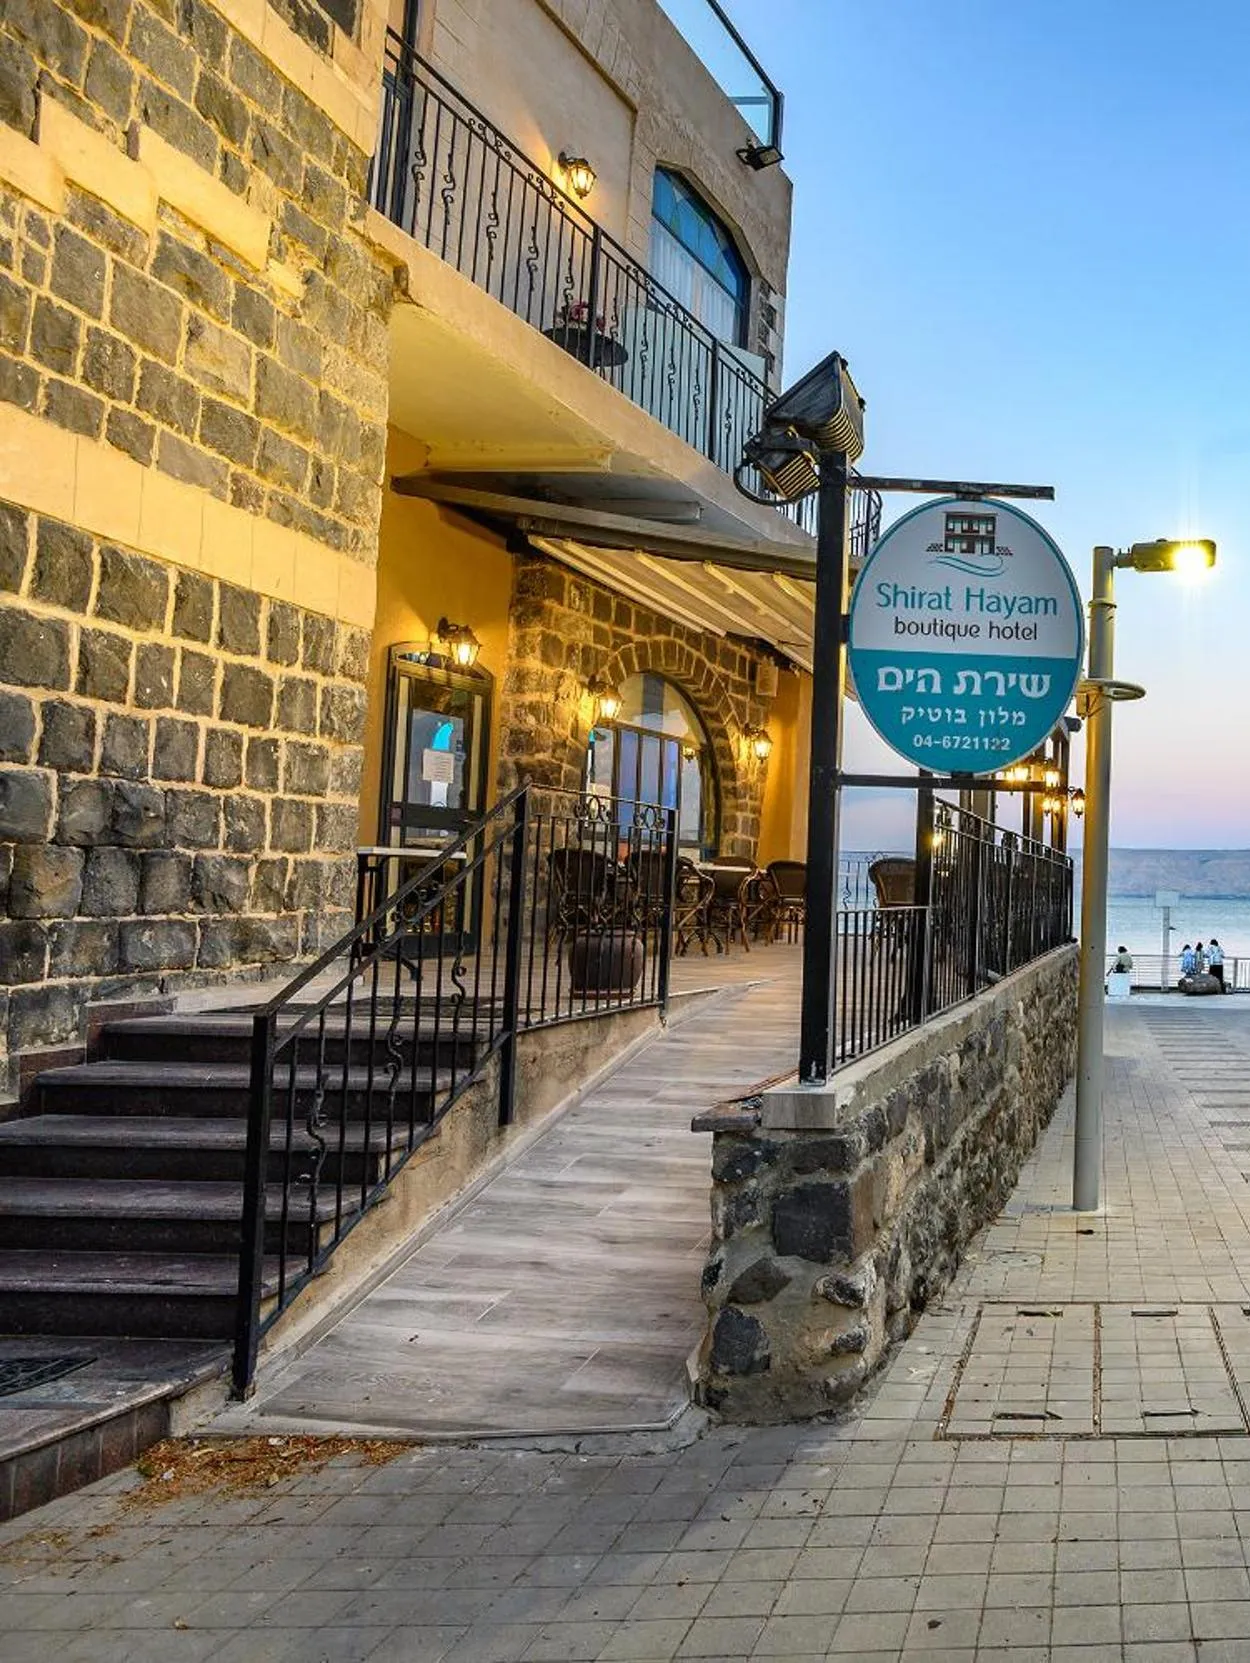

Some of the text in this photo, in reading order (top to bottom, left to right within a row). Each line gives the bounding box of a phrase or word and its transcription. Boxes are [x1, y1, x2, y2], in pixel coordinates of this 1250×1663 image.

[876, 582, 1058, 620] Shirat Hayam
[894, 616, 1038, 642] boutique hotel
[876, 665, 1052, 699] שירת הים
[900, 705, 1027, 728] מלון בוטיק
[912, 733, 1012, 752] 04-6721122
